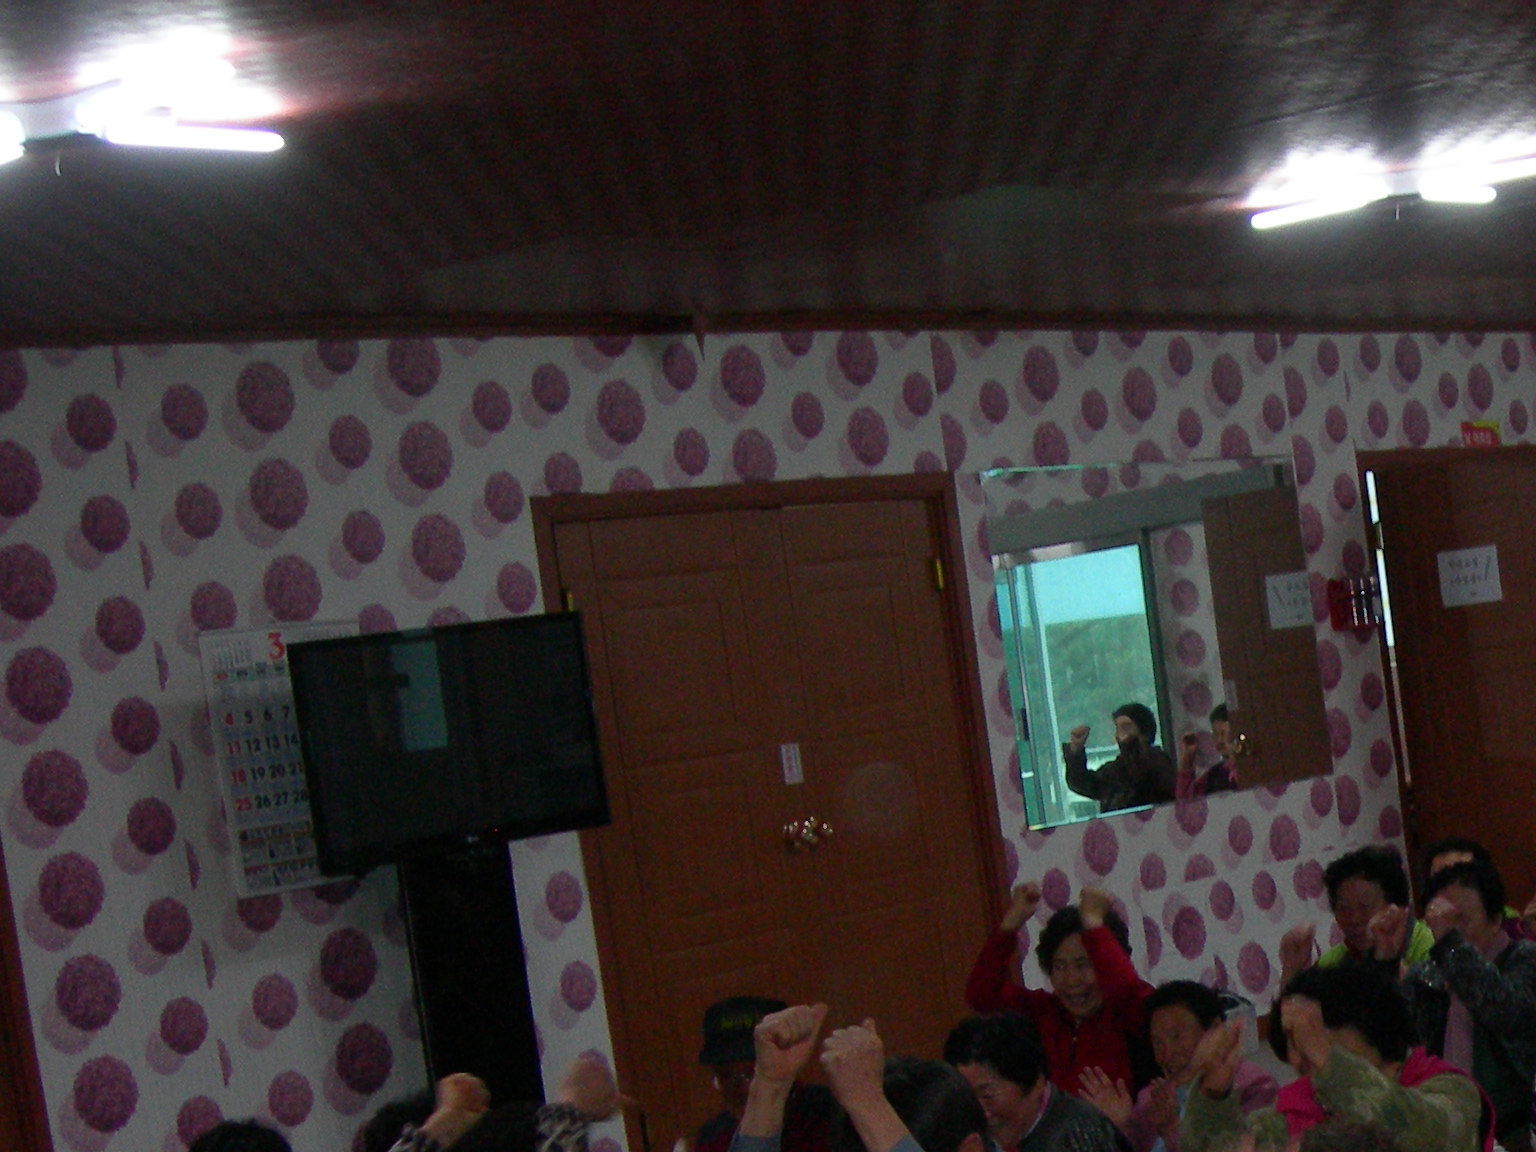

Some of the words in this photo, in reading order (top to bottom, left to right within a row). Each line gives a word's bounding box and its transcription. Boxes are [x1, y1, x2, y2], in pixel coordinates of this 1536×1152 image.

[267, 632, 285, 660] 3
[244, 709, 253, 724] 5
[263, 706, 272, 721] 6
[282, 705, 291, 720] 7
[227, 741, 241, 755] 11
[246, 738, 261, 752] 12
[265, 735, 280, 750] 13
[284, 734, 298, 748] 14
[231, 769, 246, 784] 18
[250, 766, 265, 781] 19
[269, 764, 286, 779] 20
[235, 797, 253, 812] 25
[254, 794, 271, 809] 26
[273, 792, 289, 806] 27
